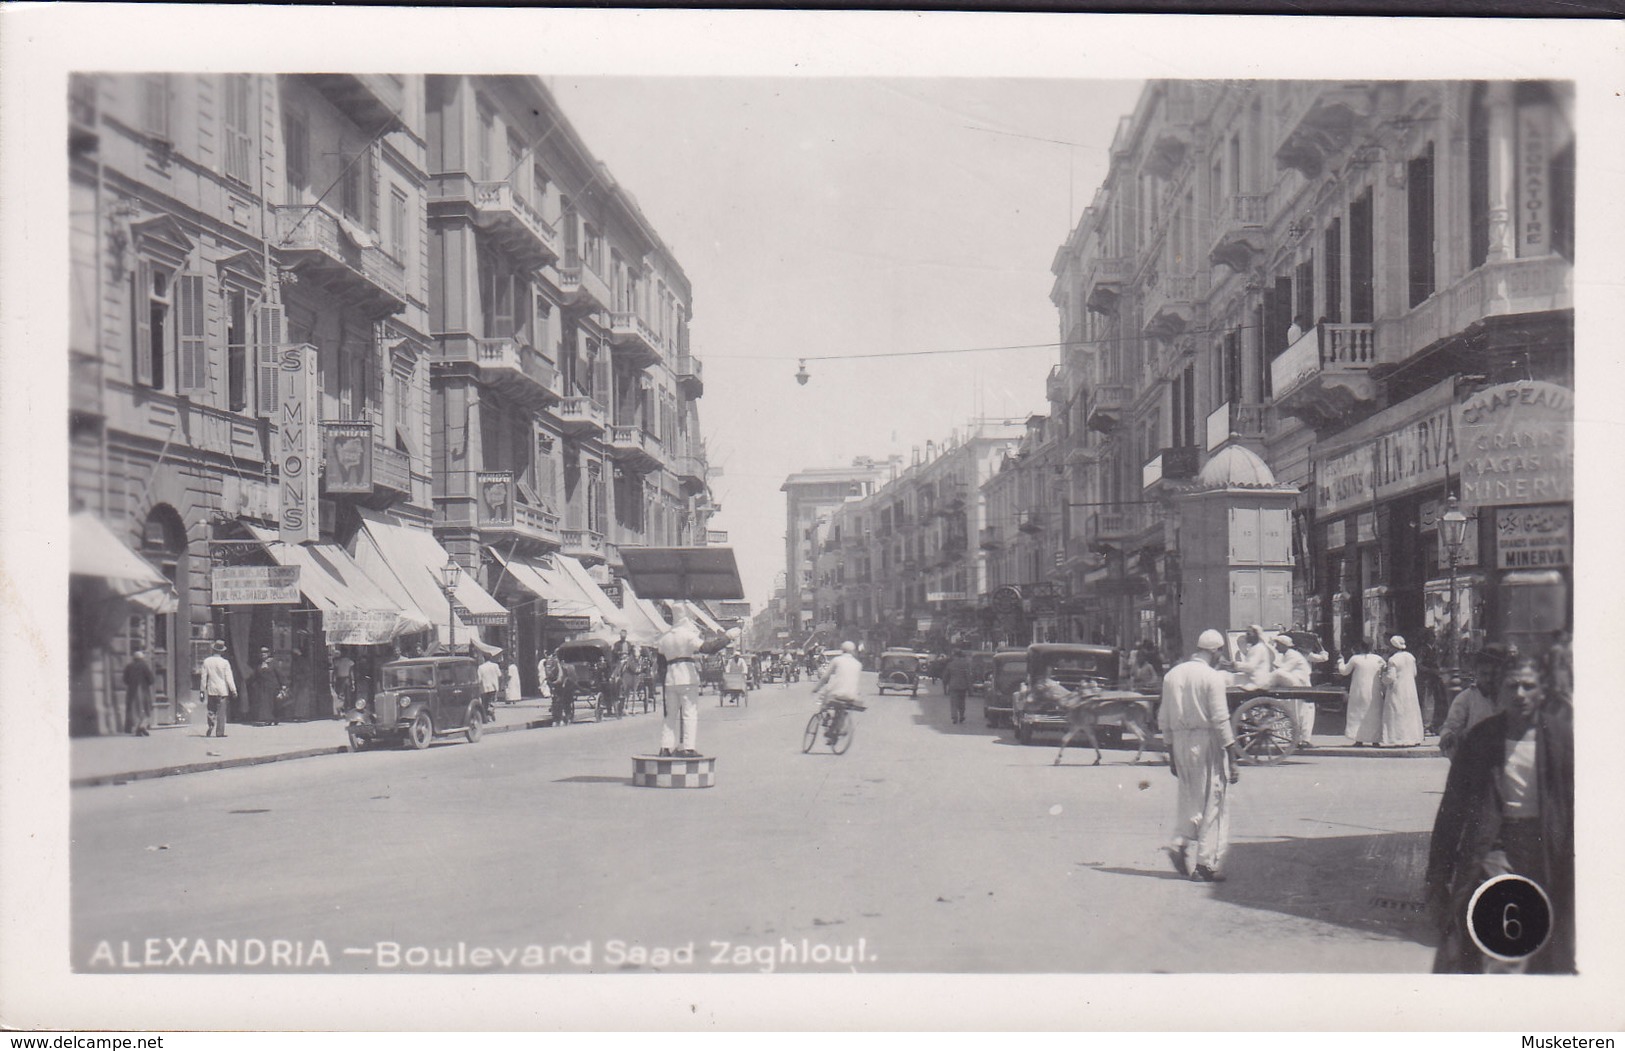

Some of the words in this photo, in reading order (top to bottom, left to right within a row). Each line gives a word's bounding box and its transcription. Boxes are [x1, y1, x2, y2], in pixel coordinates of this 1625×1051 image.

[1462, 388, 1573, 424] CHAPEAU
[281, 350, 304, 531] SIMMONS
[1463, 474, 1573, 500] MINERV
[1505, 548, 1565, 567] MINERVA
